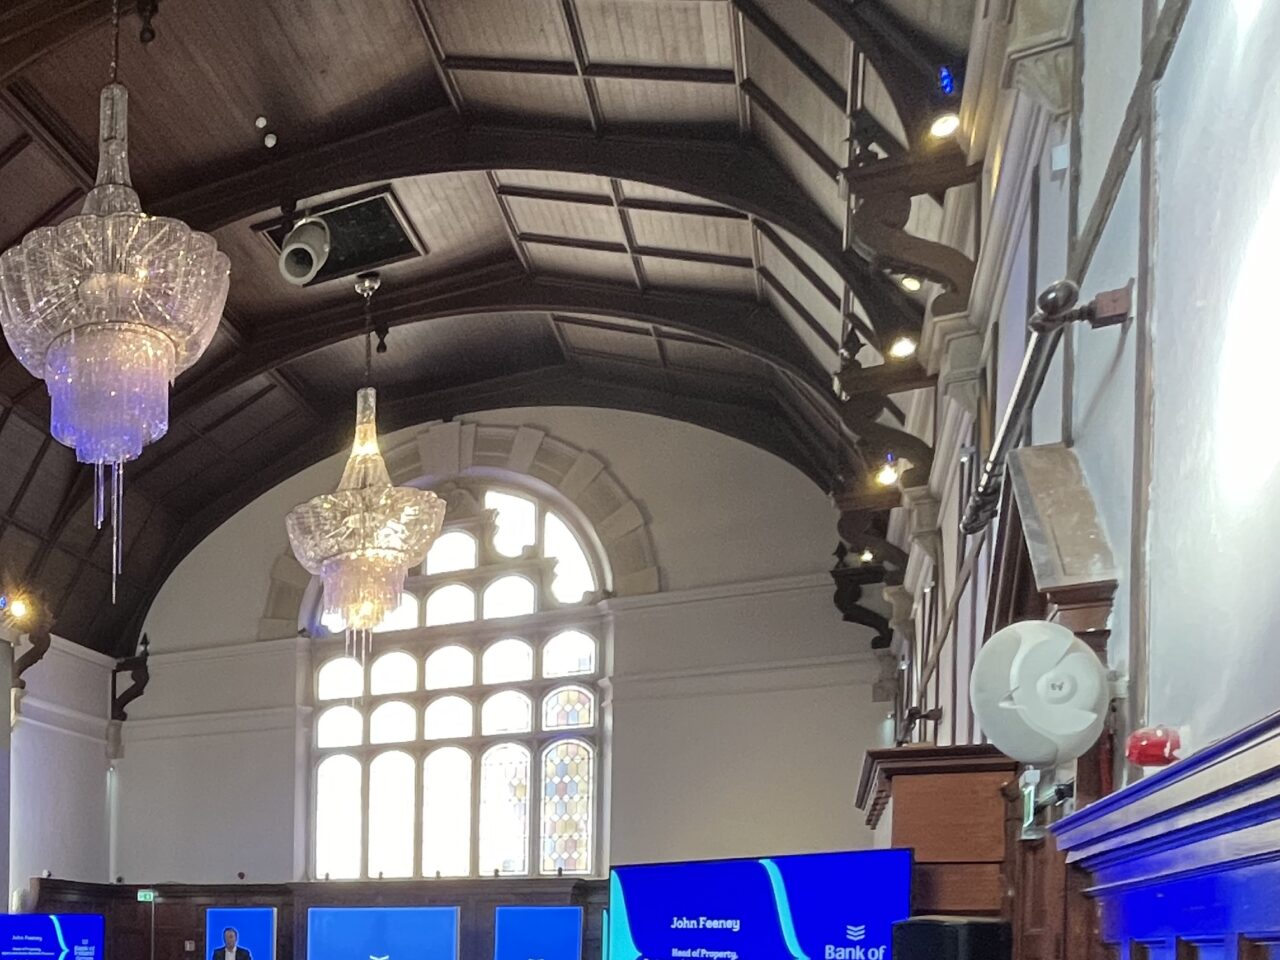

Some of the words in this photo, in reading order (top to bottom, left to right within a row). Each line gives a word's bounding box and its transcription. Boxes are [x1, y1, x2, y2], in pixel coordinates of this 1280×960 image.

[670, 917, 698, 928] John
[699, 917, 740, 932] Feeney
[672, 948, 691, 958] Head
[692, 948, 700, 958] of
[824, 944, 866, 960] Bank
[868, 945, 886, 960] of
